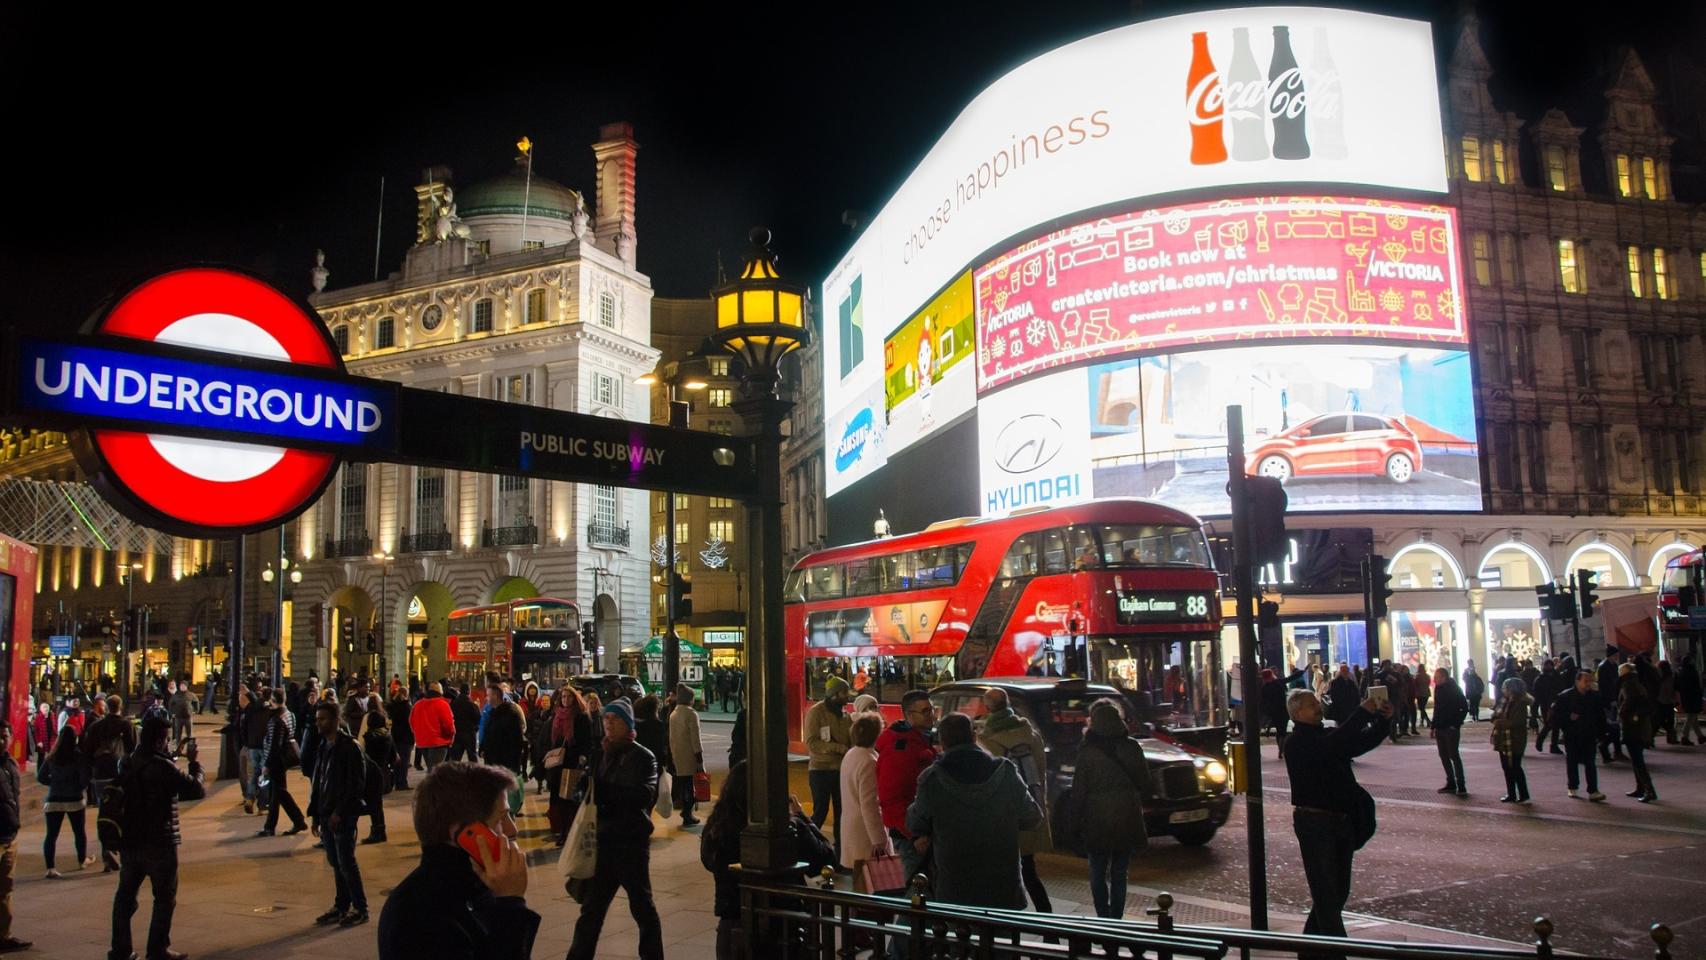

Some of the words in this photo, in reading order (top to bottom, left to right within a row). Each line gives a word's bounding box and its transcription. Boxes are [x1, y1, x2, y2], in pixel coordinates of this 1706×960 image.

[903, 198, 952, 265] choose
[956, 109, 1111, 212] happiness
[1123, 248, 1174, 274] Book
[1177, 249, 1219, 267] now
[1224, 244, 1247, 261] at
[1051, 263, 1338, 313] createvictoria.com/christmas
[34, 356, 384, 434] UNDERGROUND
[520, 431, 588, 457] PUBLIC
[592, 440, 665, 466] SUBWAY
[987, 473, 1080, 513] HYUNDAI
[1186, 595, 1208, 616] 88
[524, 641, 551, 649] Aldwych
[560, 640, 568, 650] 6
